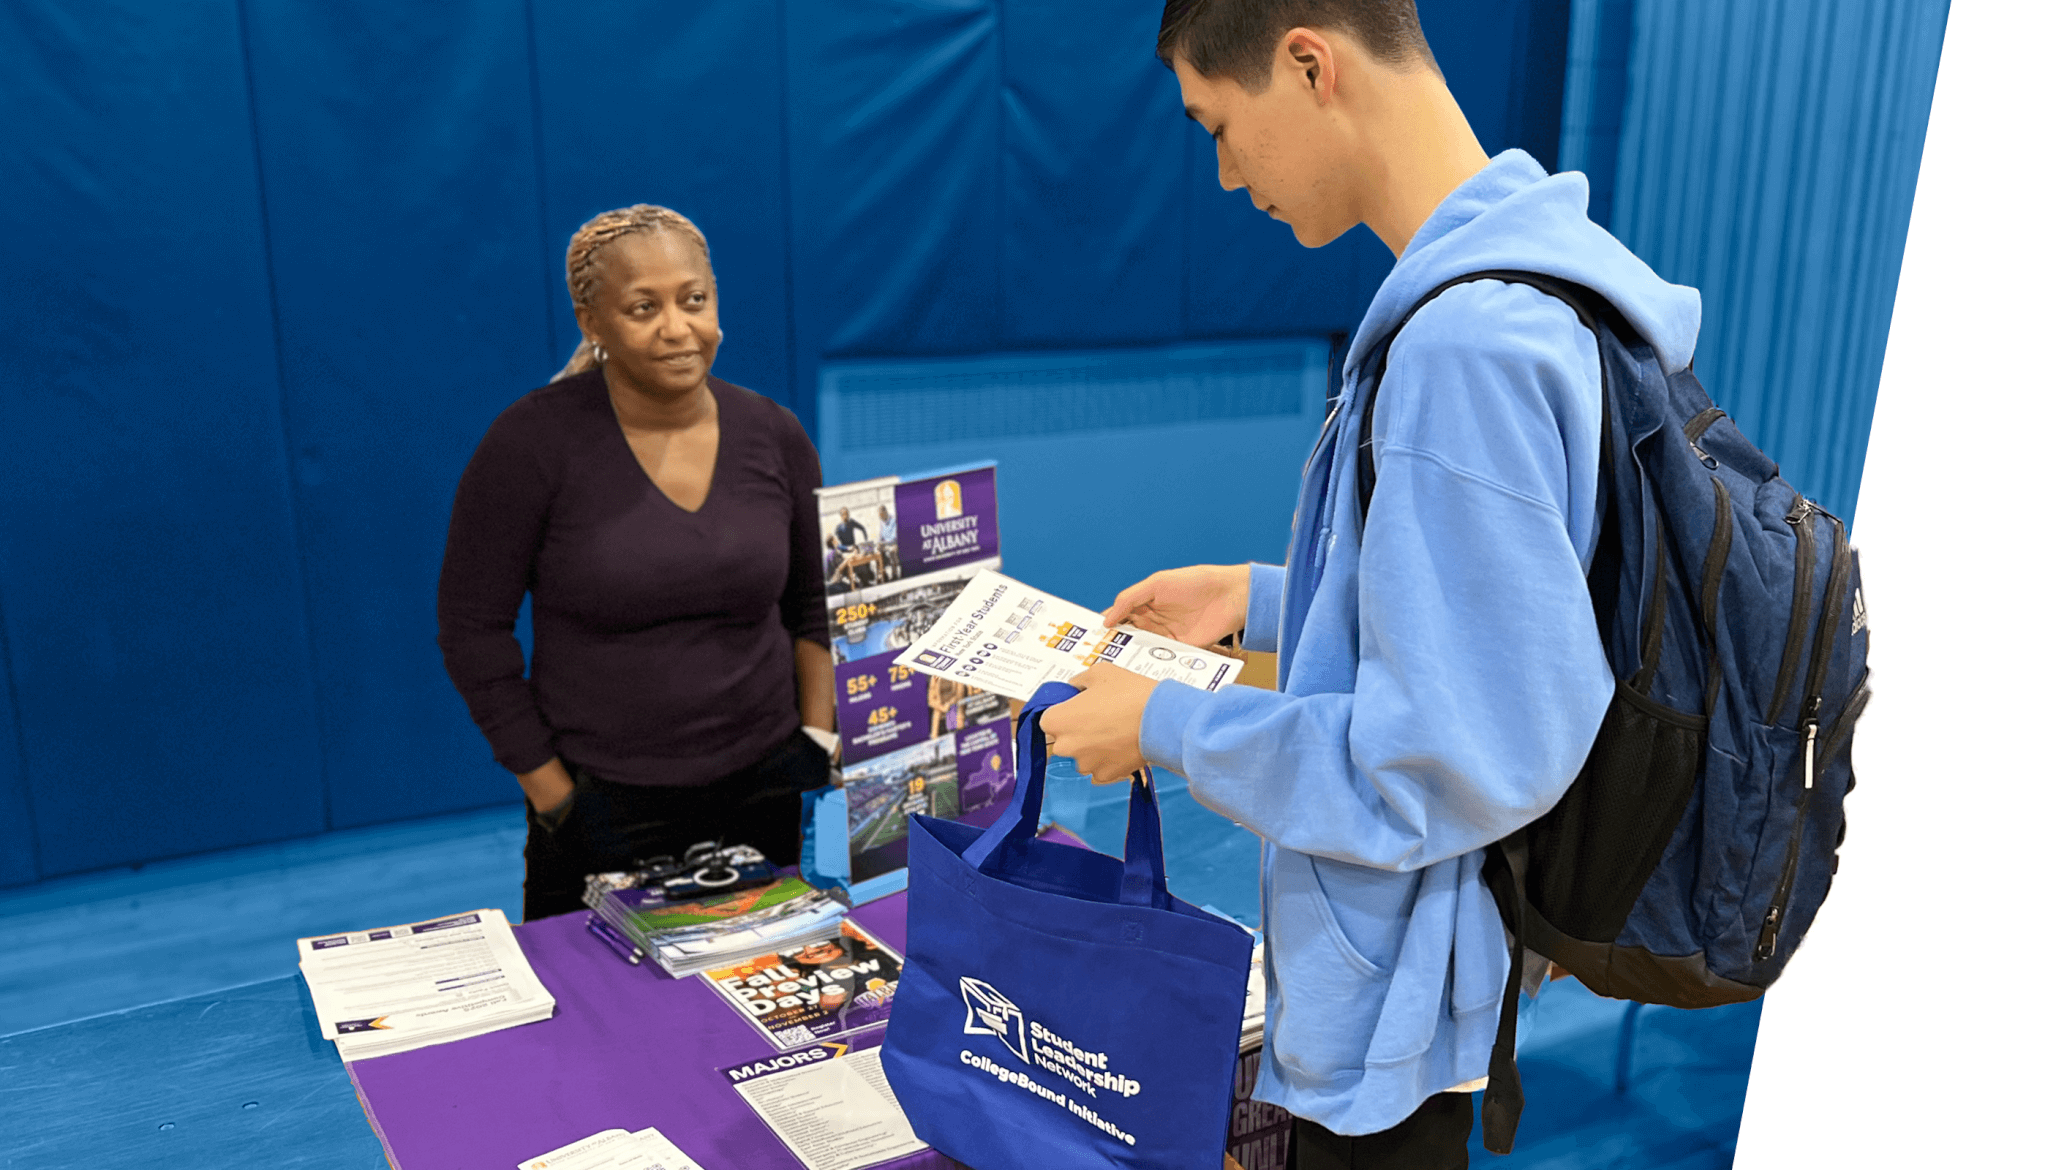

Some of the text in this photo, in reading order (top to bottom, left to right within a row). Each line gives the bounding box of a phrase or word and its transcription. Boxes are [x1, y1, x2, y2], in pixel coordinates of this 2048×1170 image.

[920, 515, 978, 538] UNIVERSITY
[922, 539, 932, 550] AT
[931, 529, 979, 555] ALBANY
[836, 603, 877, 625] 250+
[971, 584, 1008, 621] Students
[846, 674, 877, 695] 55+
[868, 706, 898, 725] 45+
[719, 964, 800, 994] Fall
[731, 959, 880, 1004] Preview
[744, 984, 846, 1016] Days
[760, 1008, 805, 1023] OCTOBER
[767, 1012, 821, 1030] NOVEMBER
[1030, 1021, 1108, 1070] Student
[729, 1047, 828, 1081] MAJORS
[1031, 1038, 1141, 1098] Leadership
[1034, 1053, 1097, 1099] Network
[960, 1050, 1066, 1108] CollegeBound
[1068, 1099, 1136, 1146] Initiative
[1233, 1100, 1292, 1137] GREA
